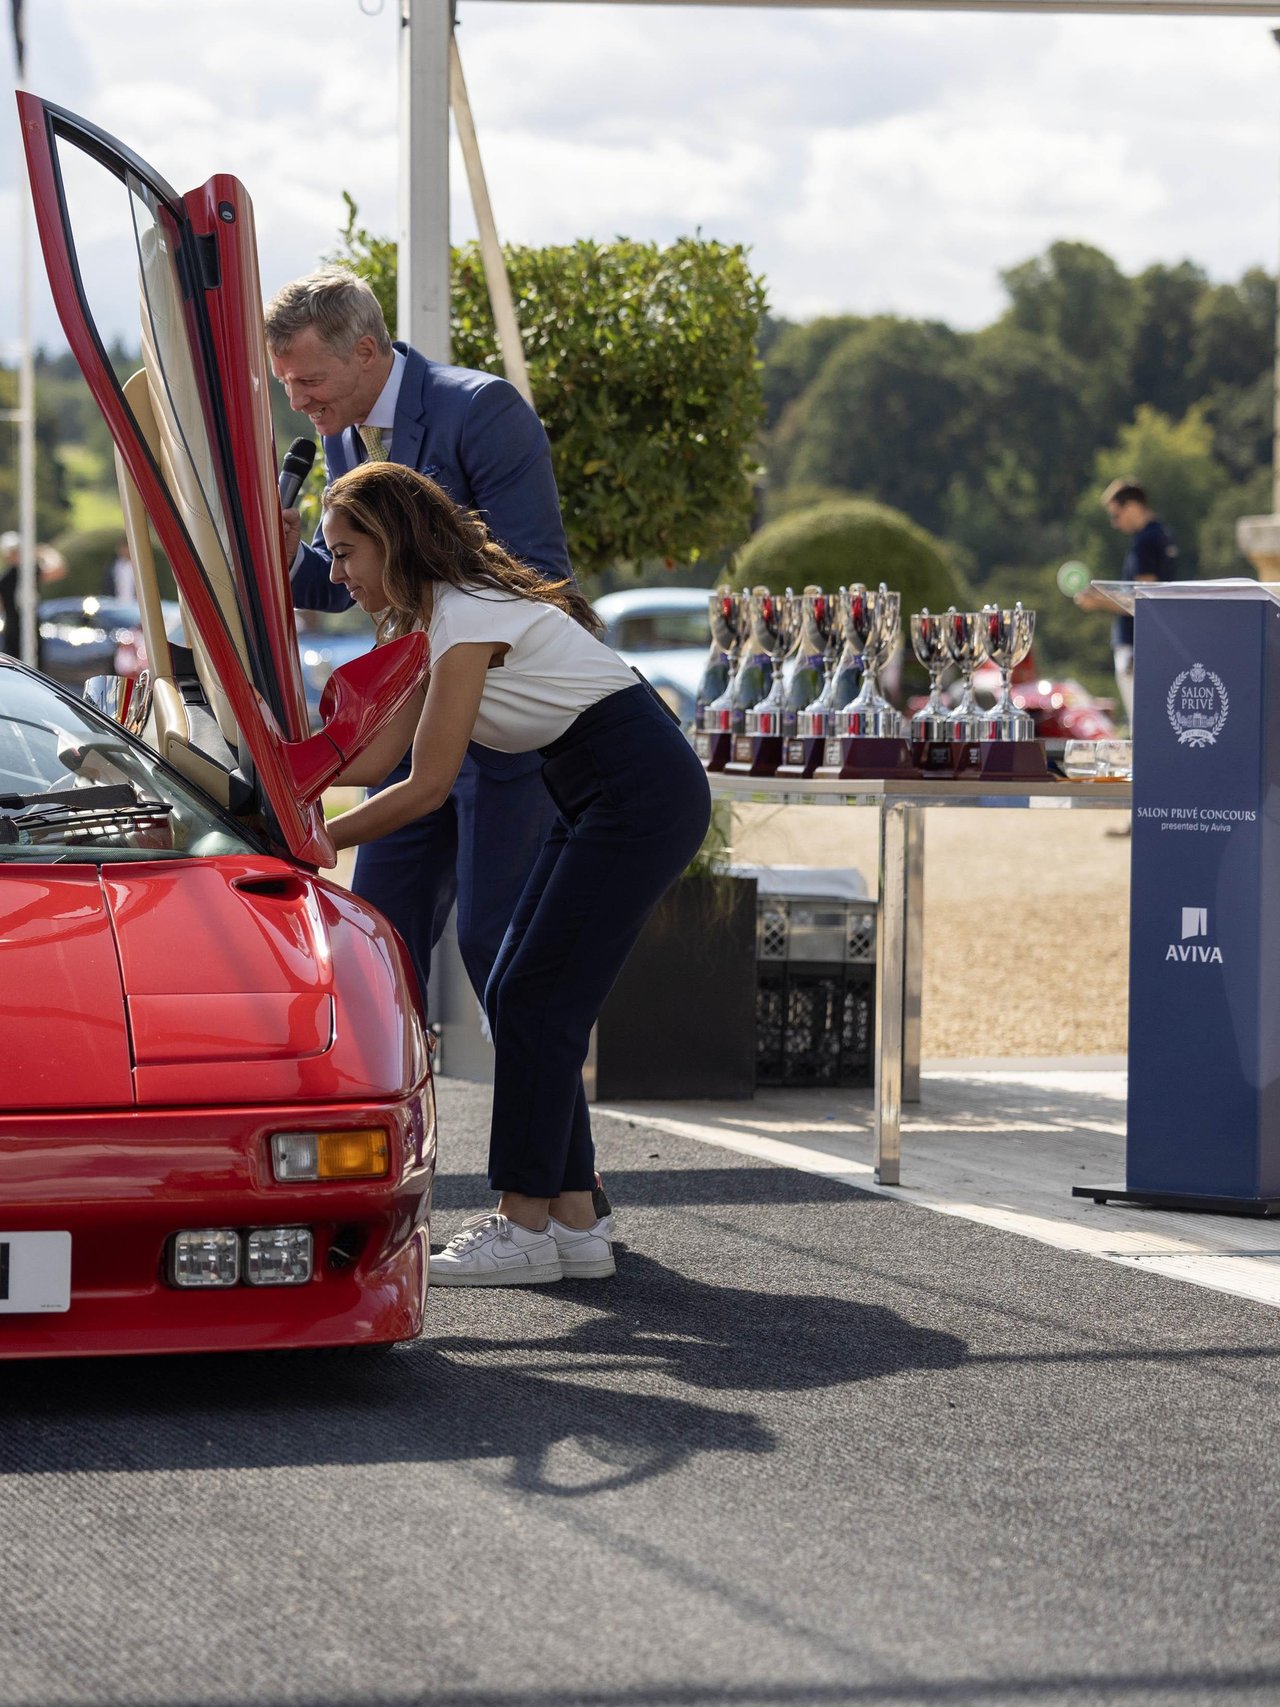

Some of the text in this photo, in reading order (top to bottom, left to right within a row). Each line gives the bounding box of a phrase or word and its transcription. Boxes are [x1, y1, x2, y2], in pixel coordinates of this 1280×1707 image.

[1181, 686, 1214, 698] SALON
[1181, 697, 1214, 710] PRIVÉ
[1137, 807, 1256, 821] SALON PRIVÉ CONCOURS
[1161, 822, 1231, 833] presented by Aviva
[1165, 944, 1223, 963] AVIVA
